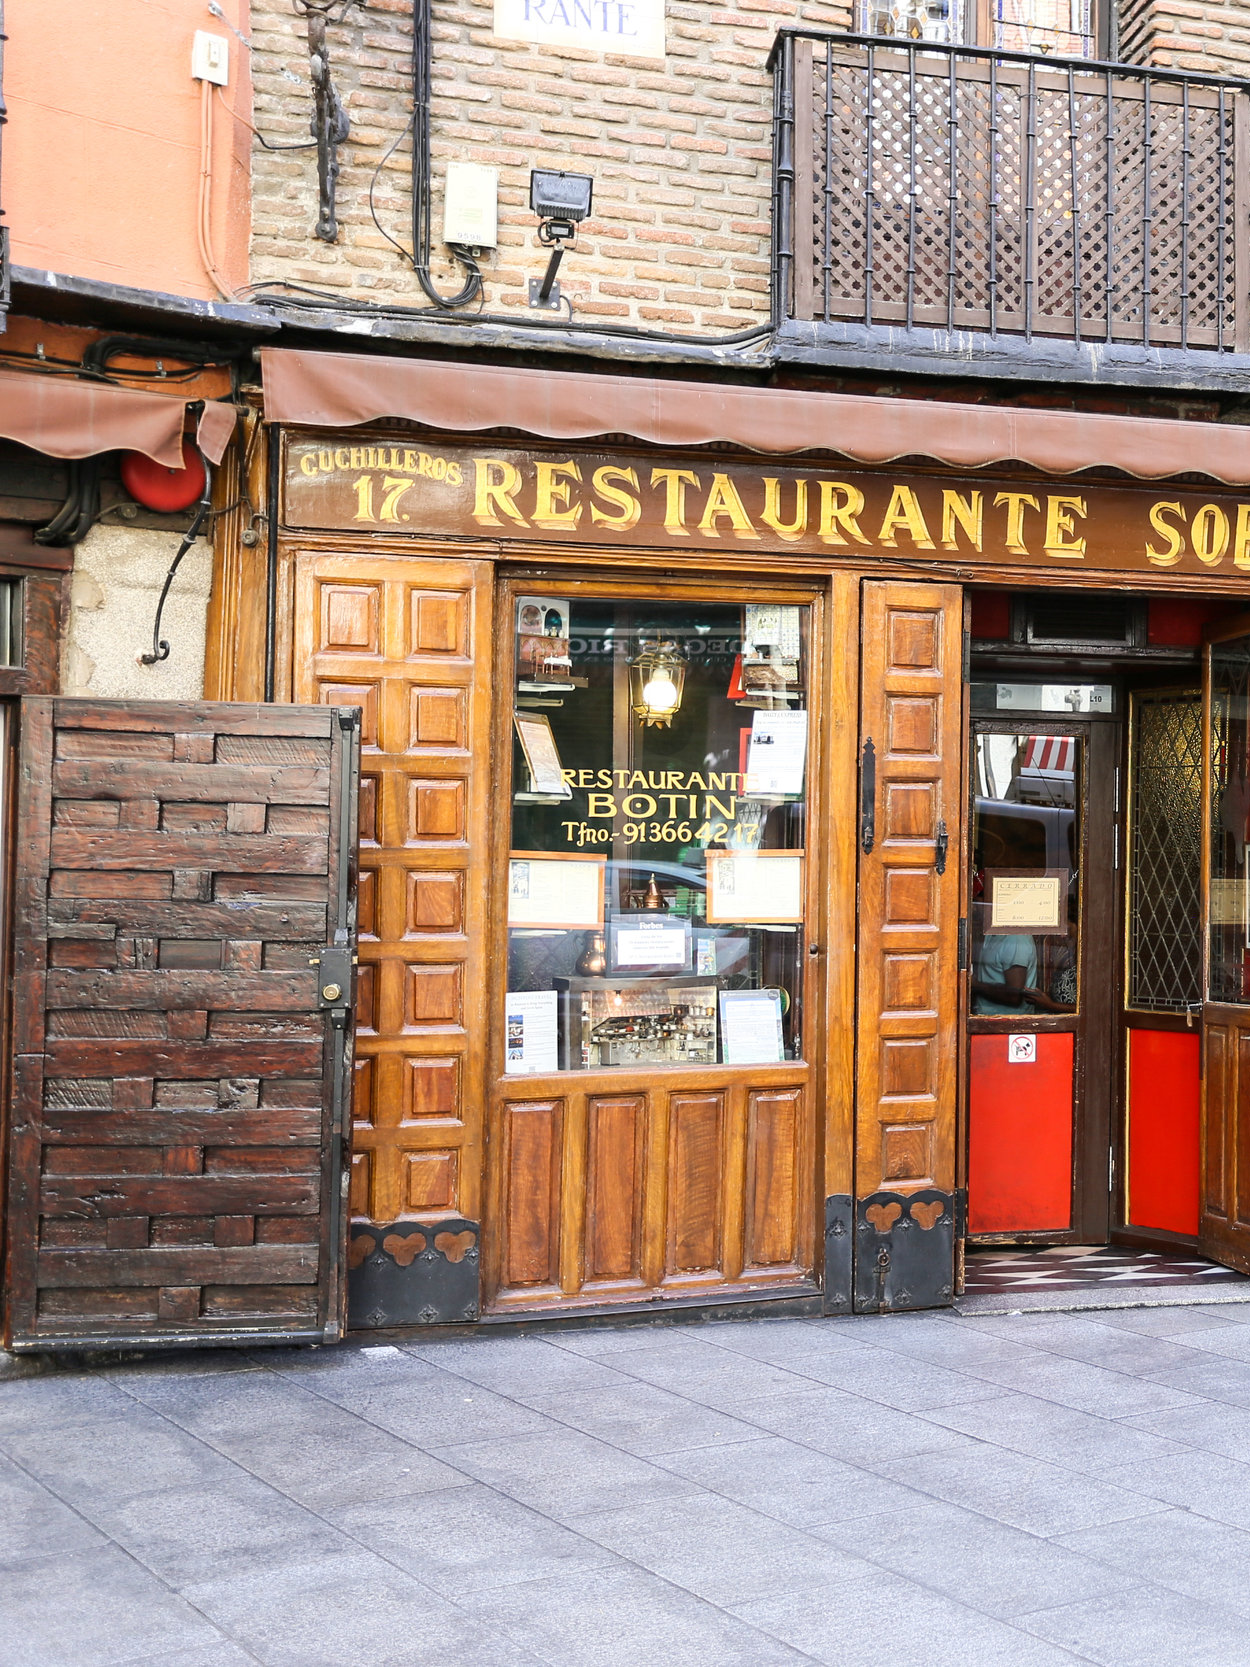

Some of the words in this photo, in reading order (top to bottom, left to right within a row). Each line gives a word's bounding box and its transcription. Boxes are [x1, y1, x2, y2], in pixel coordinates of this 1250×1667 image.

[523, 0, 638, 36] RANTE
[300, 447, 464, 488] CUCHILLEROS
[472, 458, 1088, 559] RESTAURANTE
[560, 769, 759, 791] RESTAURANTE
[588, 793, 737, 820] BOTIN
[639, 922, 664, 930] Forbes
